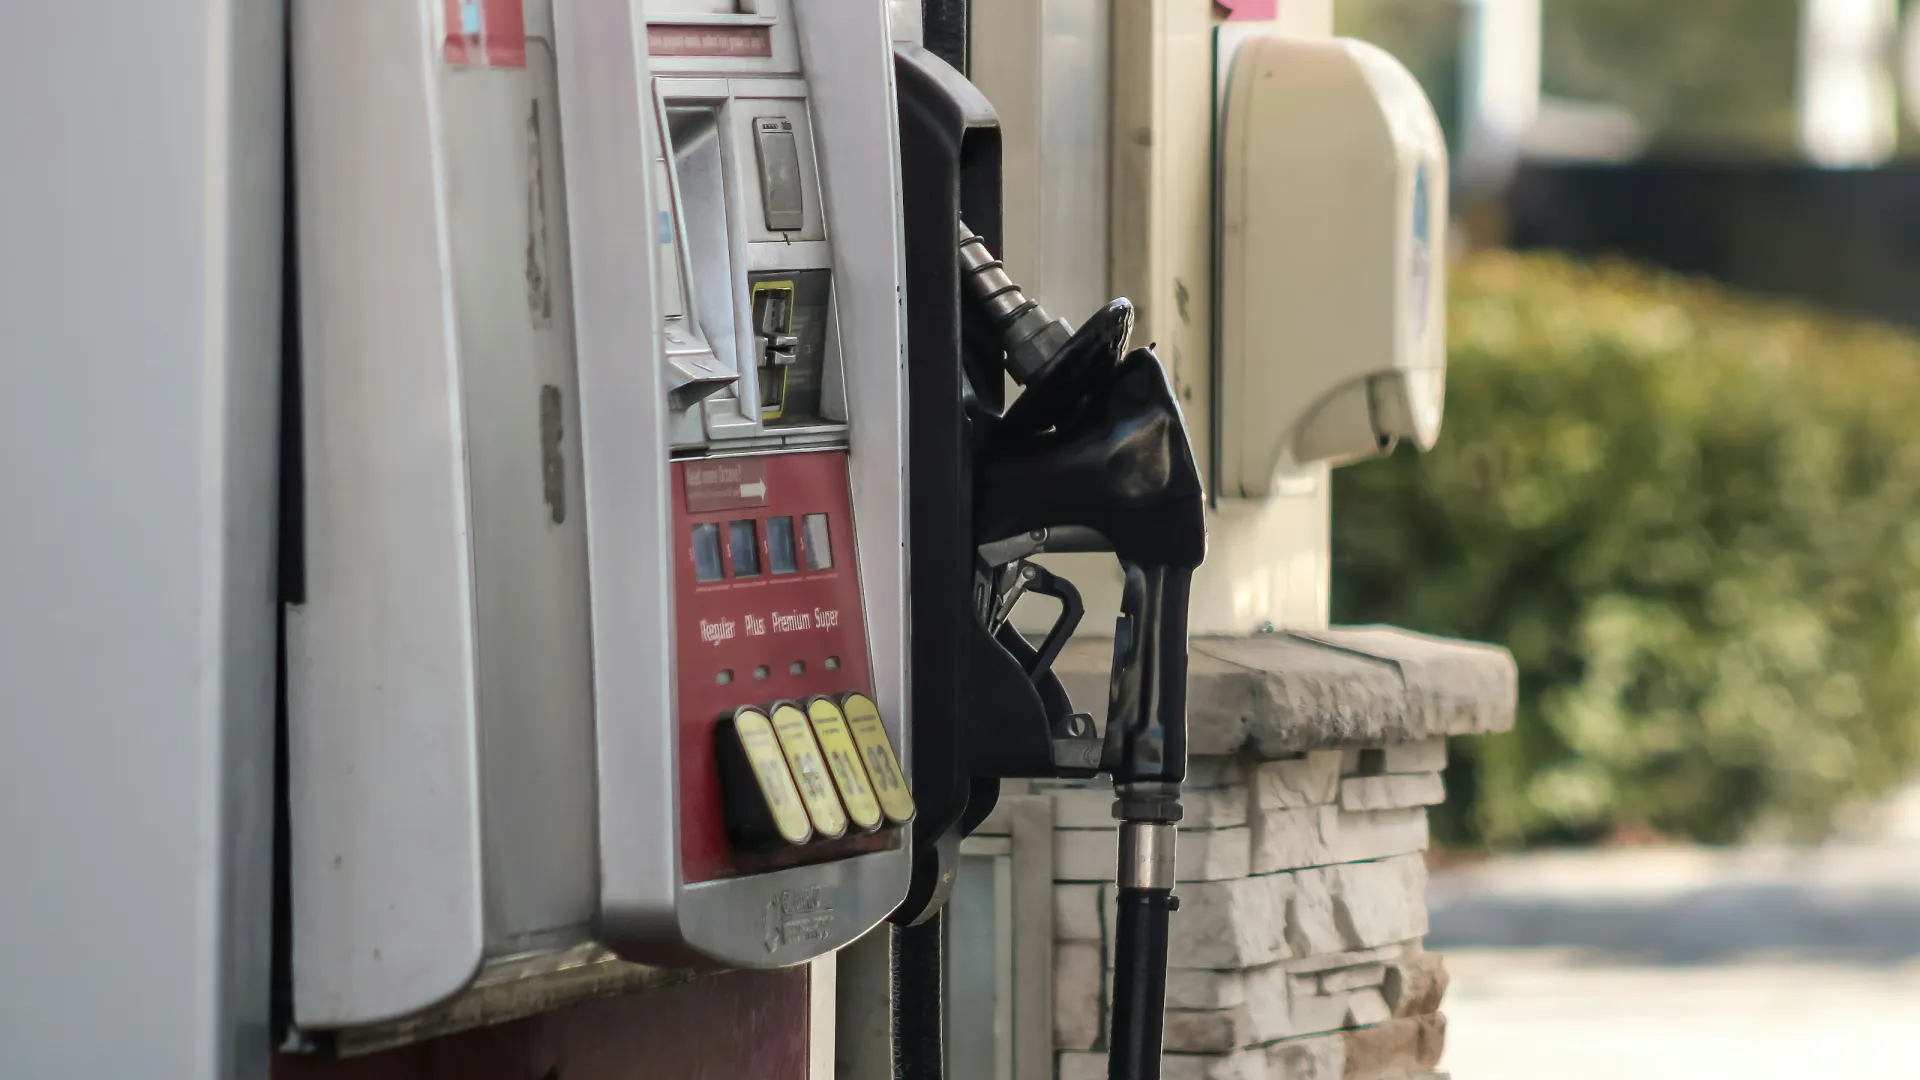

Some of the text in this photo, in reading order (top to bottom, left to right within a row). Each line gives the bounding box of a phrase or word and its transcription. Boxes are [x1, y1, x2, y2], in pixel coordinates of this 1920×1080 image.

[700, 607, 839, 646] Regular Plus Premium Super
[867, 744, 899, 792] 93
